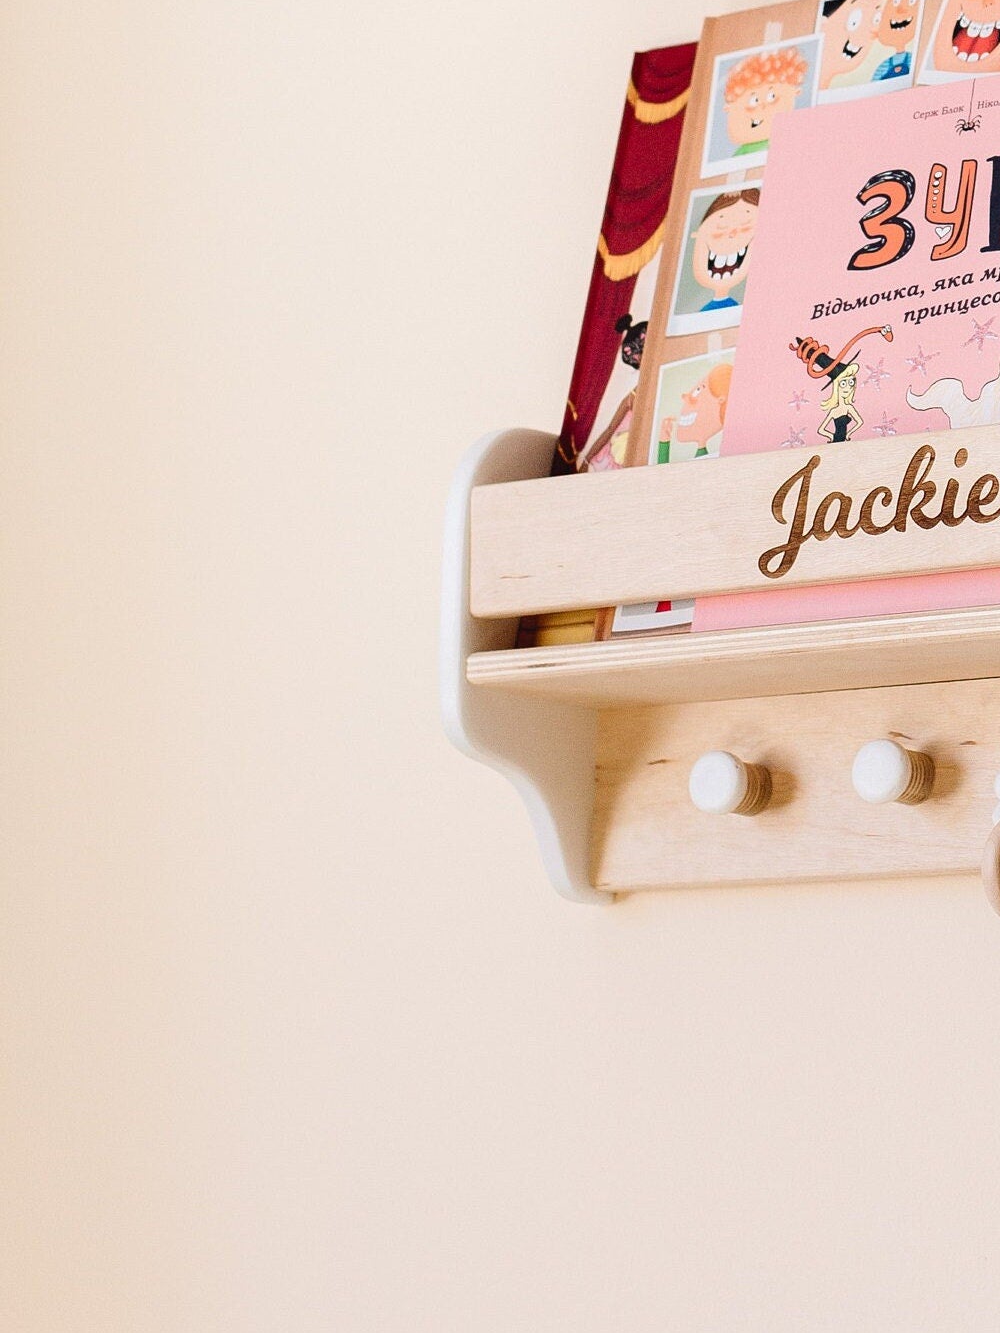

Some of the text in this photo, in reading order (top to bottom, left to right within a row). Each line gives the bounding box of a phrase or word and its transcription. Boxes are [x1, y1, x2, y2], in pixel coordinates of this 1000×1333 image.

[913, 110, 939, 121] Серж
[941, 105, 965, 116] Блок
[810, 282, 925, 320] Відьмочка,
[931, 270, 974, 292] яка
